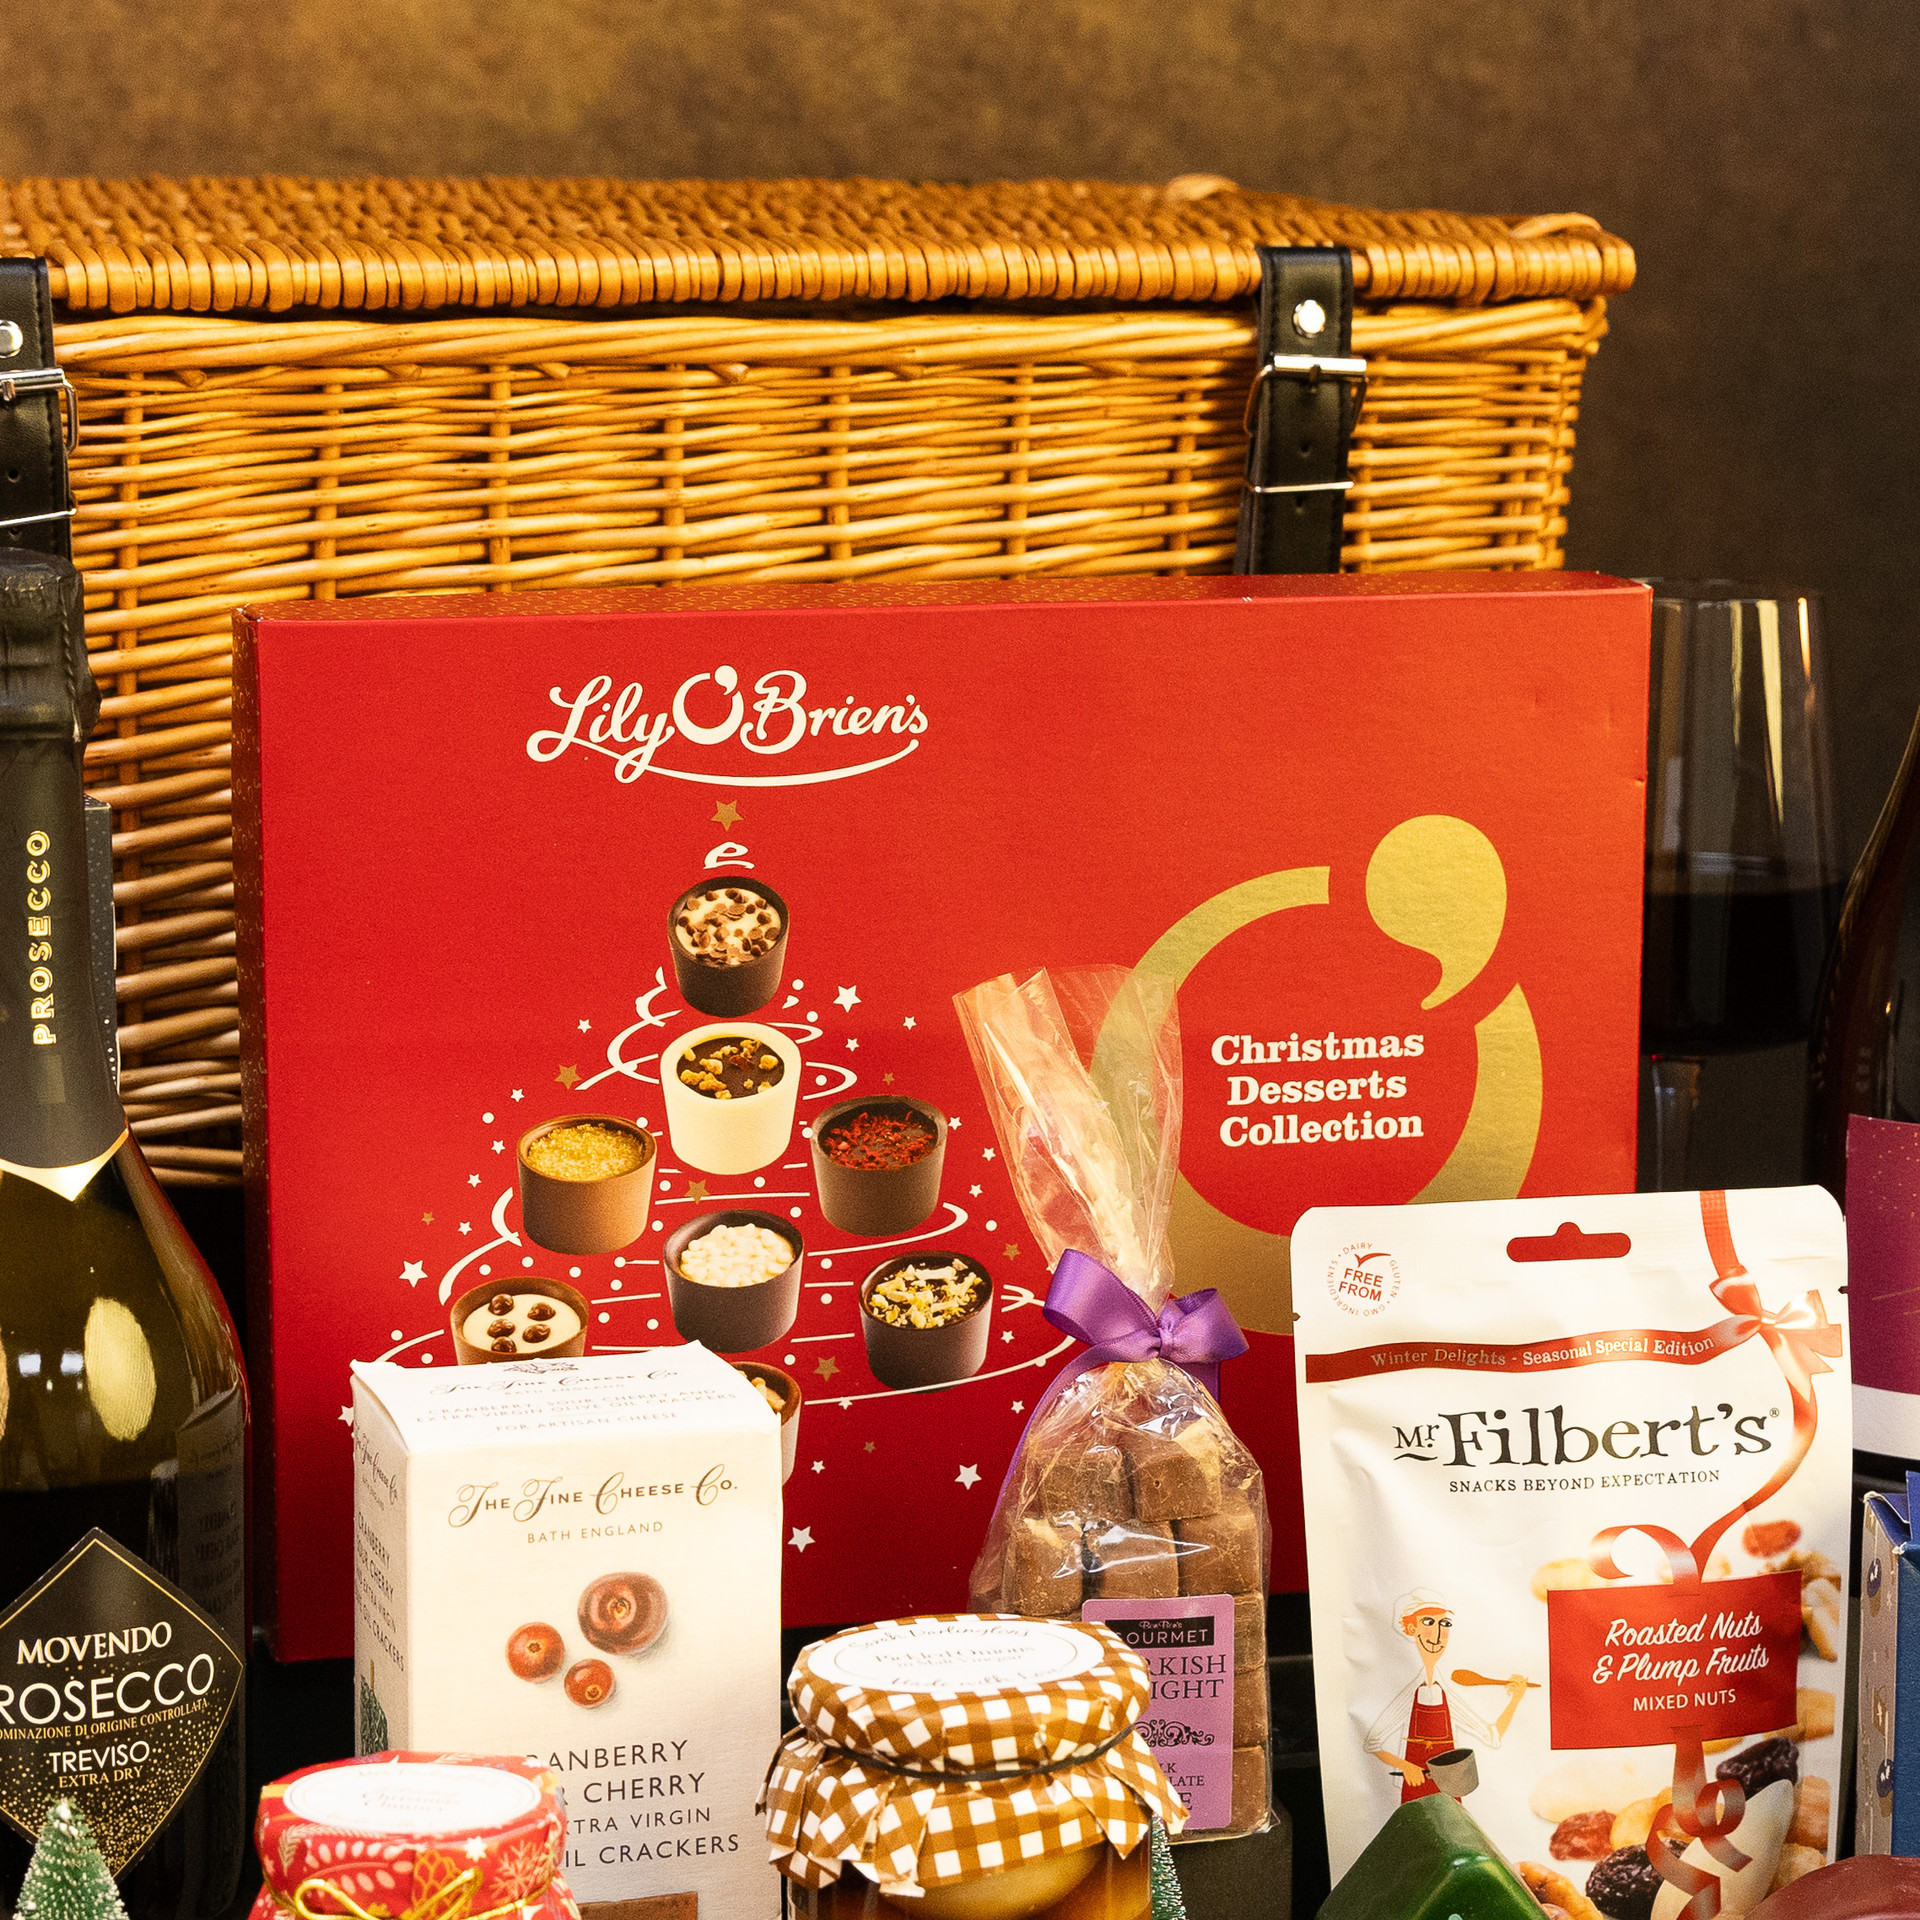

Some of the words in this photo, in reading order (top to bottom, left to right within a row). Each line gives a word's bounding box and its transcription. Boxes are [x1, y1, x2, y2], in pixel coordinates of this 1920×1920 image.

[526, 675, 675, 784] Lily
[26, 830, 57, 1045] PROSECCO
[1211, 1031, 1425, 1066] Christmas
[1226, 1070, 1408, 1106] Desserts
[1219, 1110, 1424, 1148] Collection
[1342, 1242, 1373, 1255] DAIRY
[1327, 1259, 1359, 1316] INGREDIENTS
[1338, 1281, 1382, 1302] FROM
[1343, 1267, 1384, 1288] FREE
[1389, 1259, 1401, 1298] GLUTEN
[1362, 1303, 1386, 1317] GMO
[1370, 1350, 1428, 1367] Winter
[1434, 1348, 1506, 1367] Delights
[1522, 1340, 1591, 1366] Seasonal
[1595, 1337, 1648, 1355] Special
[1653, 1335, 1715, 1357] Edition
[1449, 1478, 1517, 1493] SNACKS
[1523, 1476, 1595, 1492] BEYOND
[1600, 1469, 1720, 1489] EXPECTATION
[527, 1529, 571, 1544] BATH
[581, 1521, 664, 1539] ENGLAND
[16, 1621, 173, 1665] MOVENDO
[1126, 1629, 1209, 1645] OURMET
[1605, 1613, 1707, 1647] Roasted
[1709, 1610, 1763, 1640] Nuts
[1592, 1654, 1614, 1684] &
[1616, 1652, 1700, 1686] Plump
[1705, 1643, 1769, 1675] Fruits
[0, 1653, 215, 1725] ROSECCO
[1150, 1678, 1225, 1700] IGHT
[1633, 1693, 1689, 1711] MIXED
[1694, 1688, 1737, 1707] NUTS
[75, 1724, 88, 1737] DI
[90, 1716, 138, 1735] ORIGINE
[140, 1697, 209, 1727] CONTROLLATA
[49, 1740, 151, 1774] TREVISO
[548, 1739, 688, 1772] ANBERRY
[58, 1771, 110, 1789] EXTRA
[113, 1765, 144, 1782] DRY
[583, 1772, 705, 1804] CHERRY
[629, 1807, 711, 1829] VIRGIN
[565, 1849, 586, 1868] IL
[599, 1834, 739, 1865] CRACKERS
